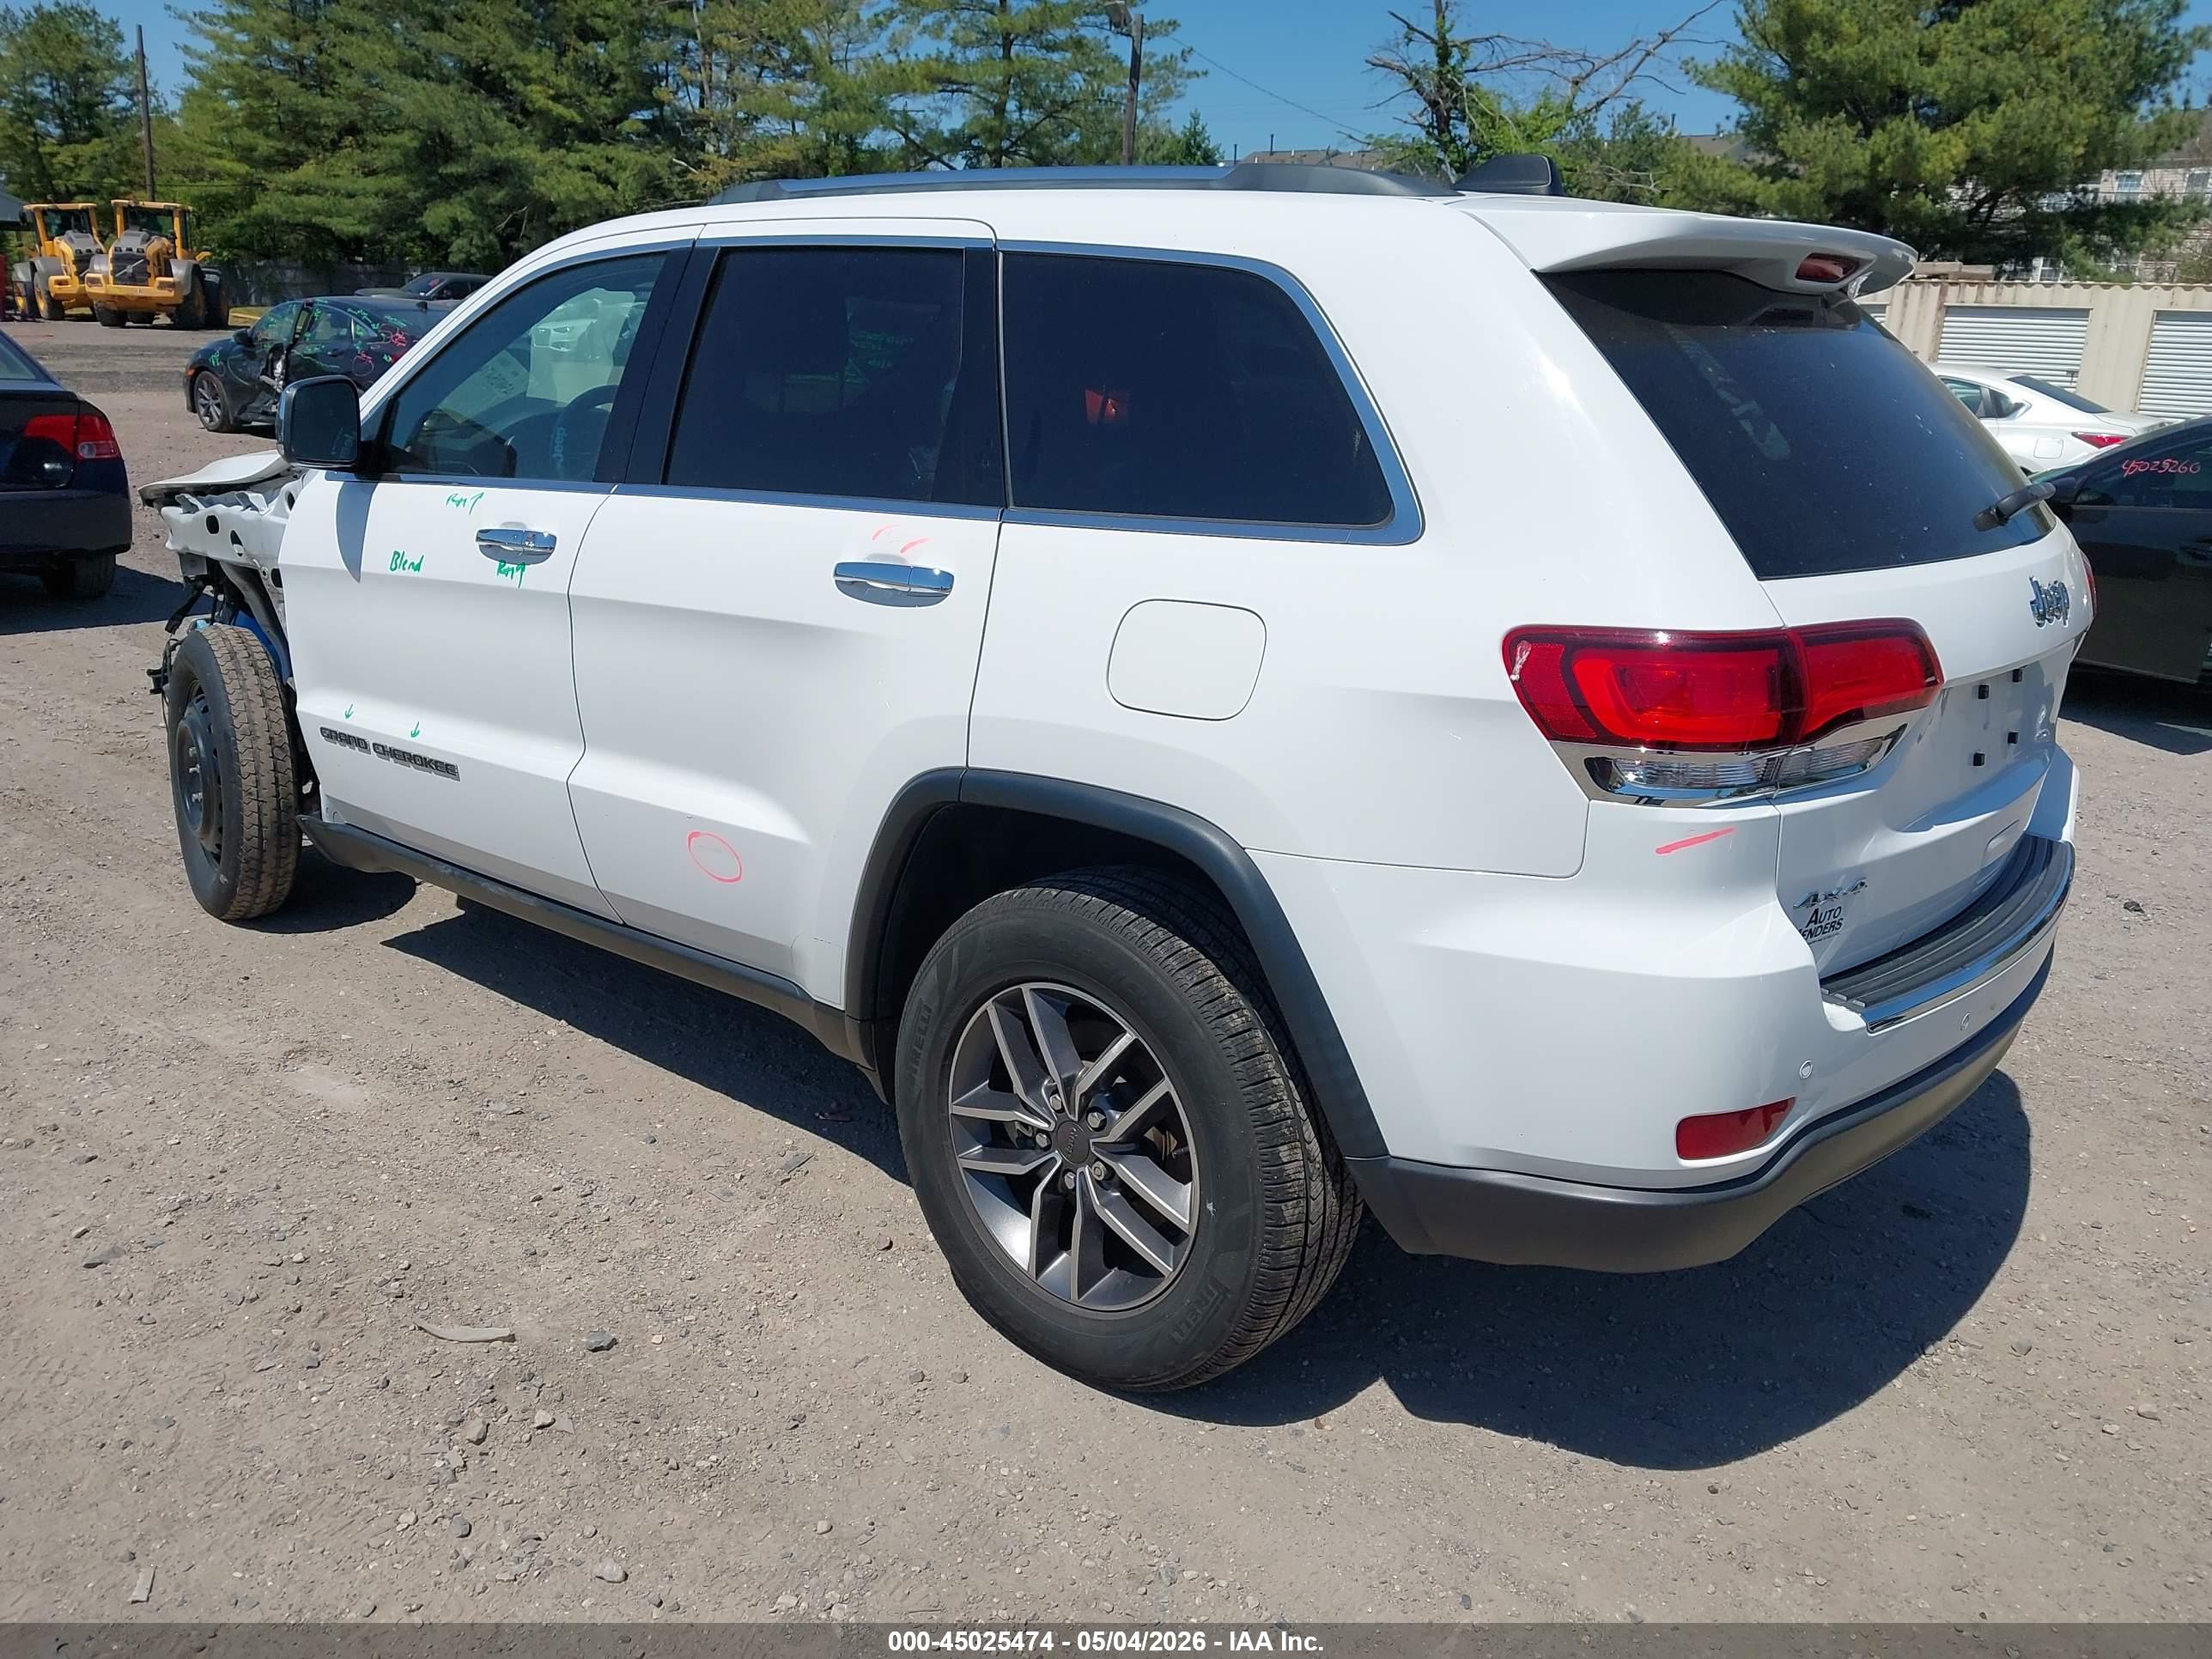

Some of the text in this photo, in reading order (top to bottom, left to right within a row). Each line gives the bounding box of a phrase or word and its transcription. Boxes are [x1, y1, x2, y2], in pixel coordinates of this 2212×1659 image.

[389, 550, 424, 571] Blend
[319, 726, 460, 781] GRAND CHEROKEE
